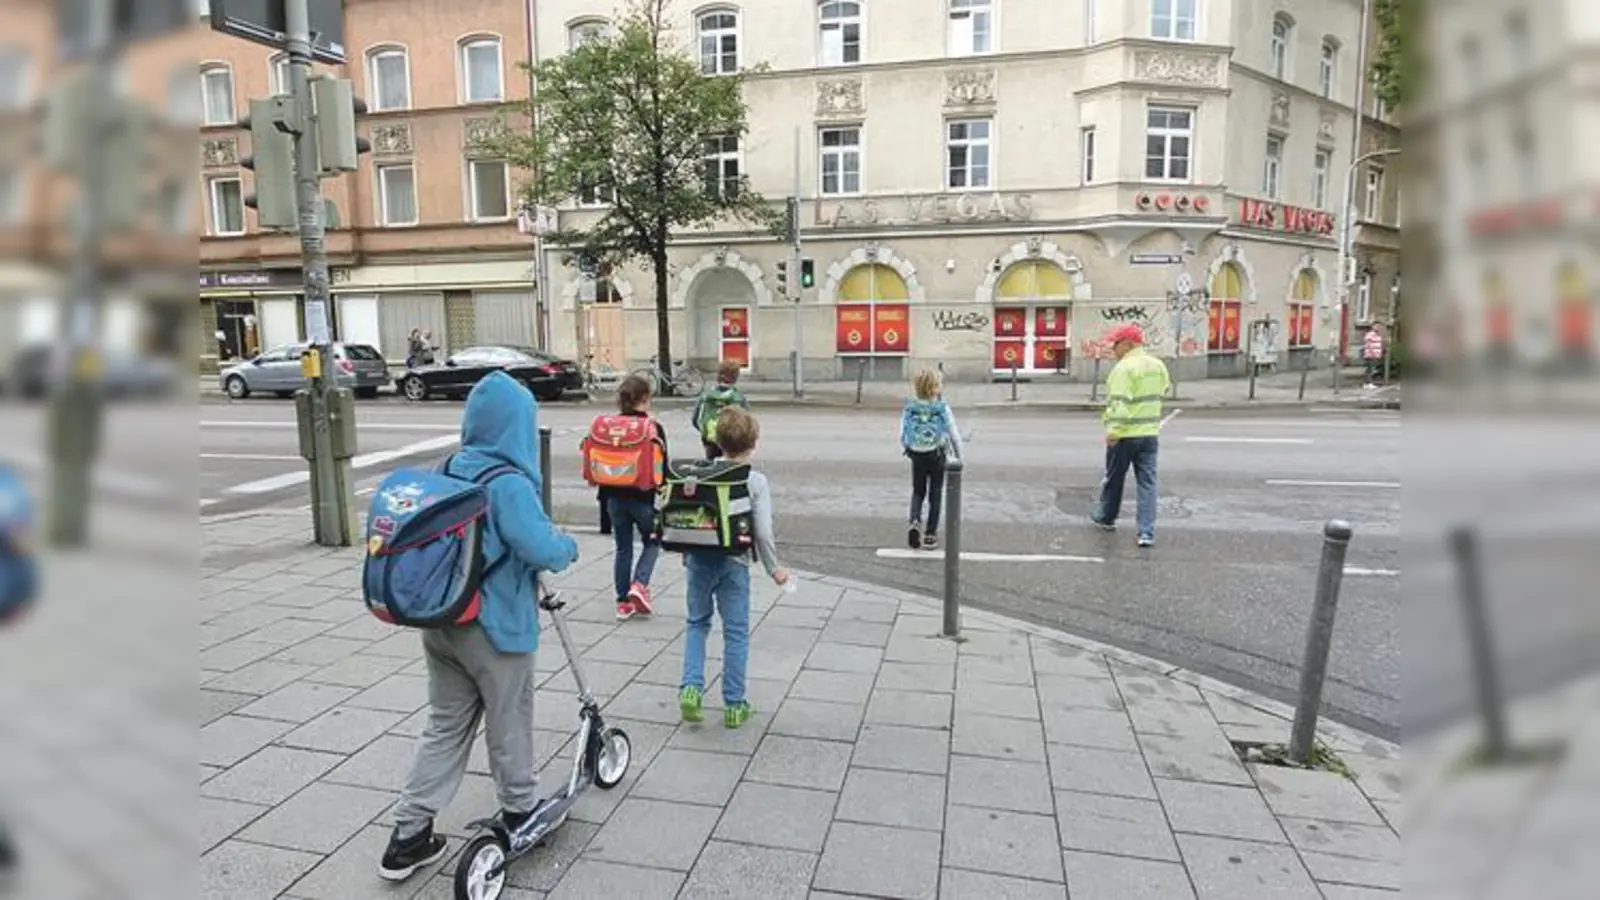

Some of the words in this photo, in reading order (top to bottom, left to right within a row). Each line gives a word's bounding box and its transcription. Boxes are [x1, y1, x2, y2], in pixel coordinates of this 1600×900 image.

[815, 198, 878, 228] LAS
[904, 192, 1032, 224] VEGAS
[1240, 198, 1276, 227] LAS
[1284, 205, 1336, 235] VEGAS
